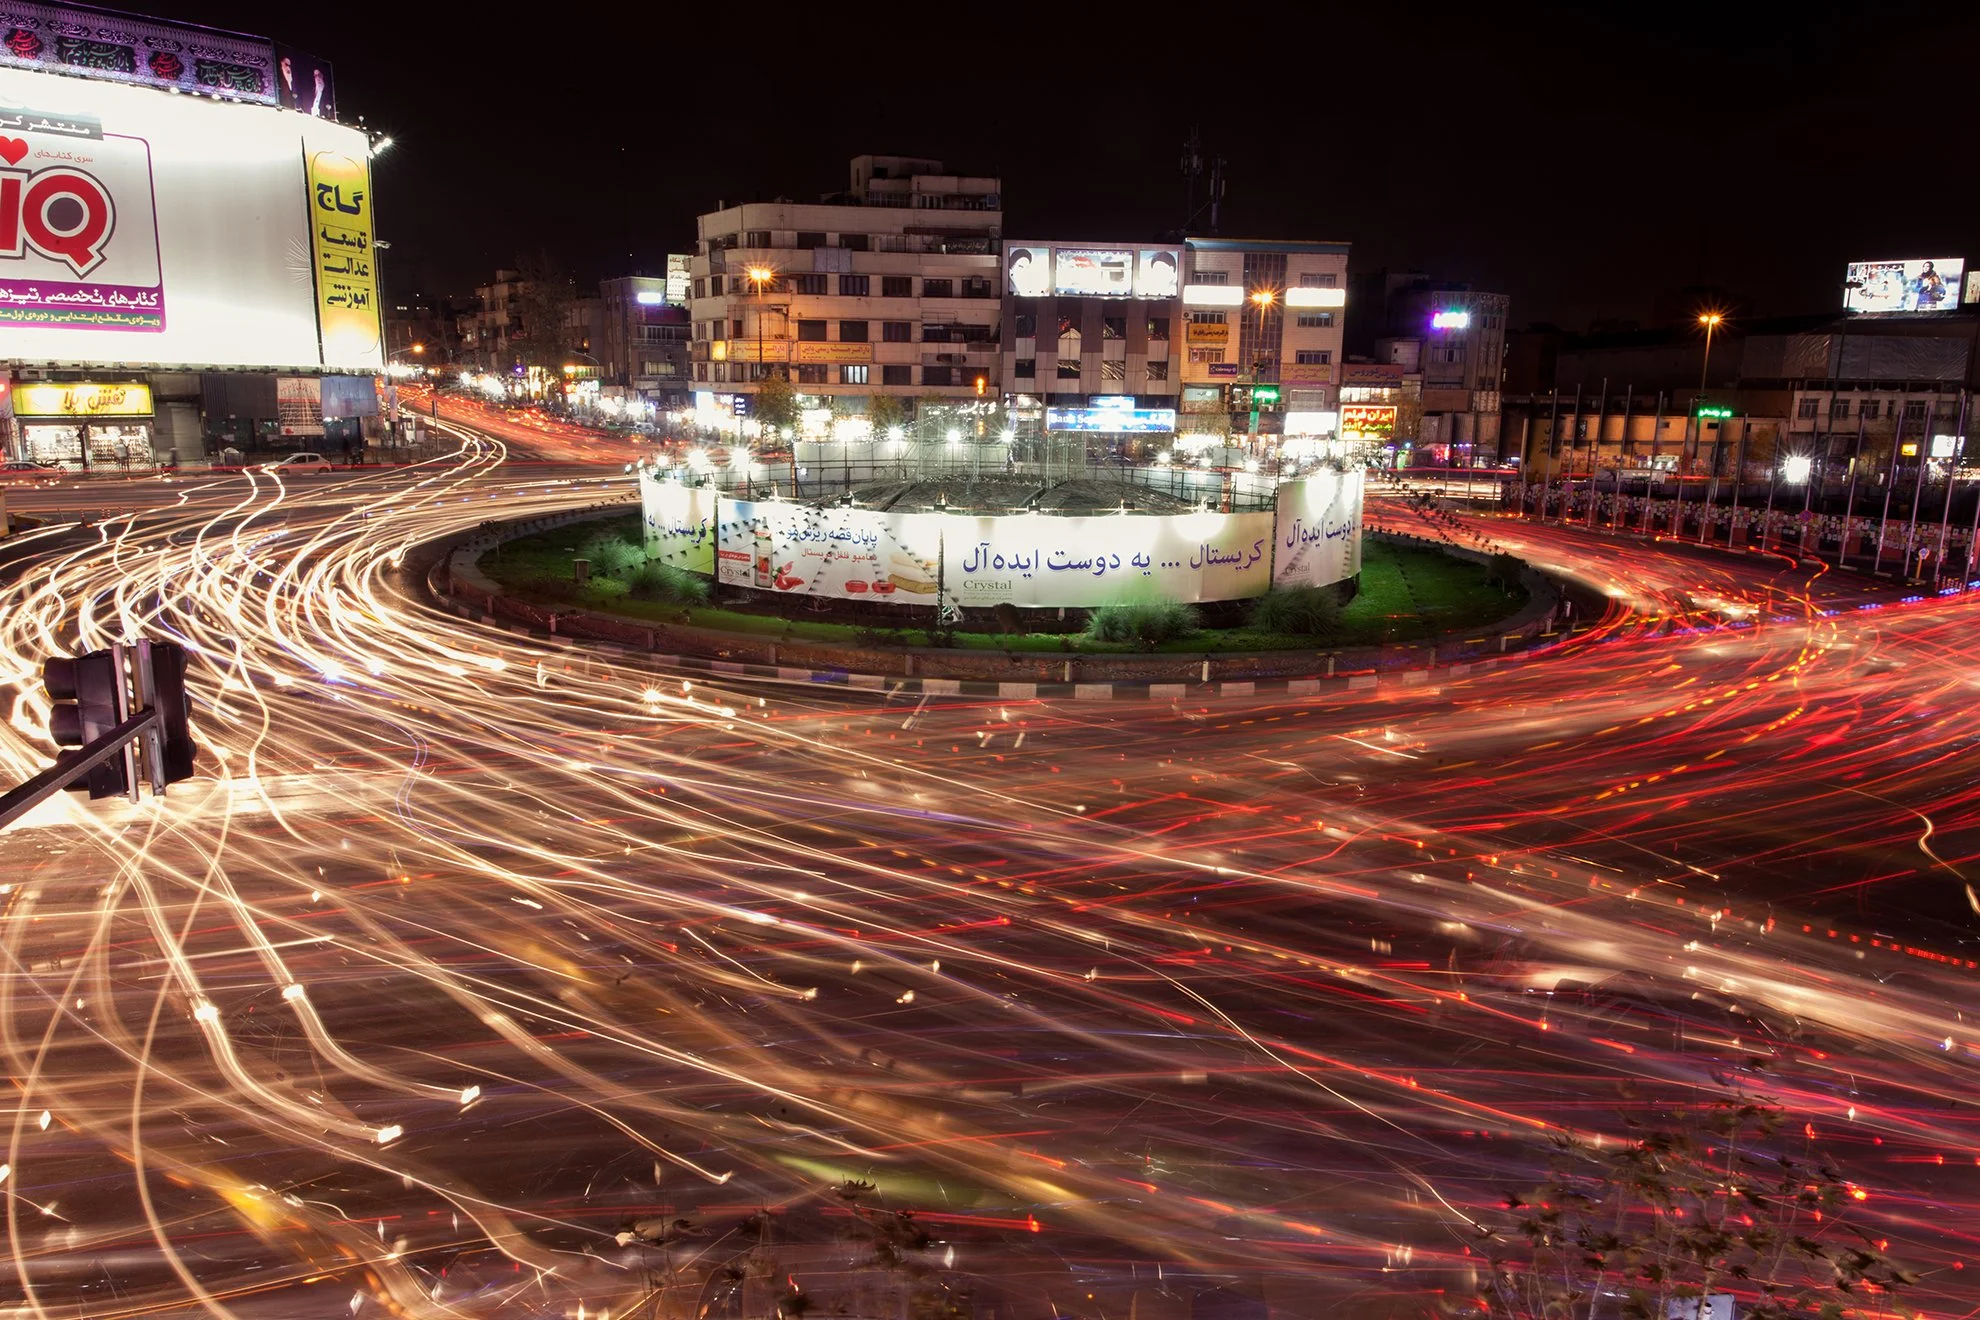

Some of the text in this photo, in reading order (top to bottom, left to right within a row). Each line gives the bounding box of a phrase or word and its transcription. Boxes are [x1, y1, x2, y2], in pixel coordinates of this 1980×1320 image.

[74, 153, 94, 164] سری
[317, 182, 363, 215] گاج
[321, 226, 367, 254] توسعه
[323, 253, 369, 277] عدالت
[39, 289, 103, 304] تخصصی
[326, 284, 370, 310] آموزشی
[54, 311, 98, 322] ابتدایی
[97, 313, 129, 325] مقطع
[1344, 407, 1393, 422] ایران فیلم
[668, 516, 707, 544] کریستال
[786, 525, 878, 548] پایان قصه ریزش مو
[1286, 518, 1352, 548] دوست ایده آل
[963, 542, 990, 573] آل
[992, 549, 1039, 578] ایده
[1047, 550, 1121, 576] دوست
[1131, 551, 1151, 576] یه
[1189, 538, 1265, 570] کریستال
[962, 579, 1013, 592] Crystal
